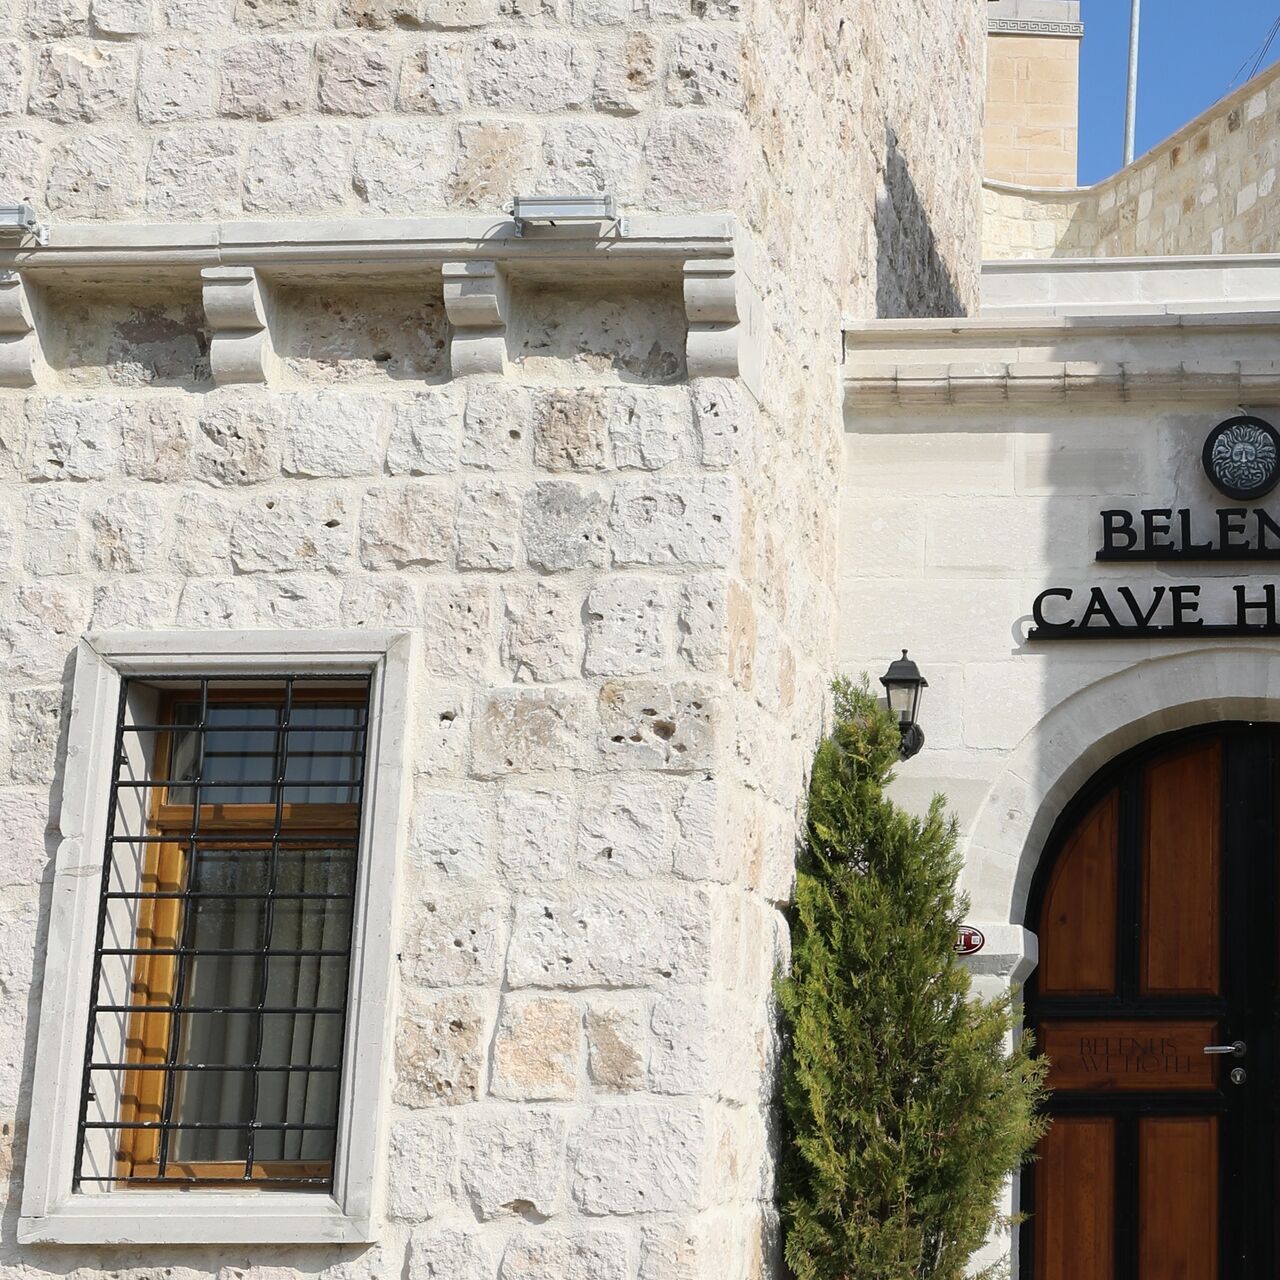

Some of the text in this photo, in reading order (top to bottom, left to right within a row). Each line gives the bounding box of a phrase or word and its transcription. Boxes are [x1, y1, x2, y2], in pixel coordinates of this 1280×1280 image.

[1031, 585, 1204, 629] CAVE
[1079, 1037, 1178, 1055] BELENUS
[1055, 1055, 1196, 1073] CAVE HOTEL
